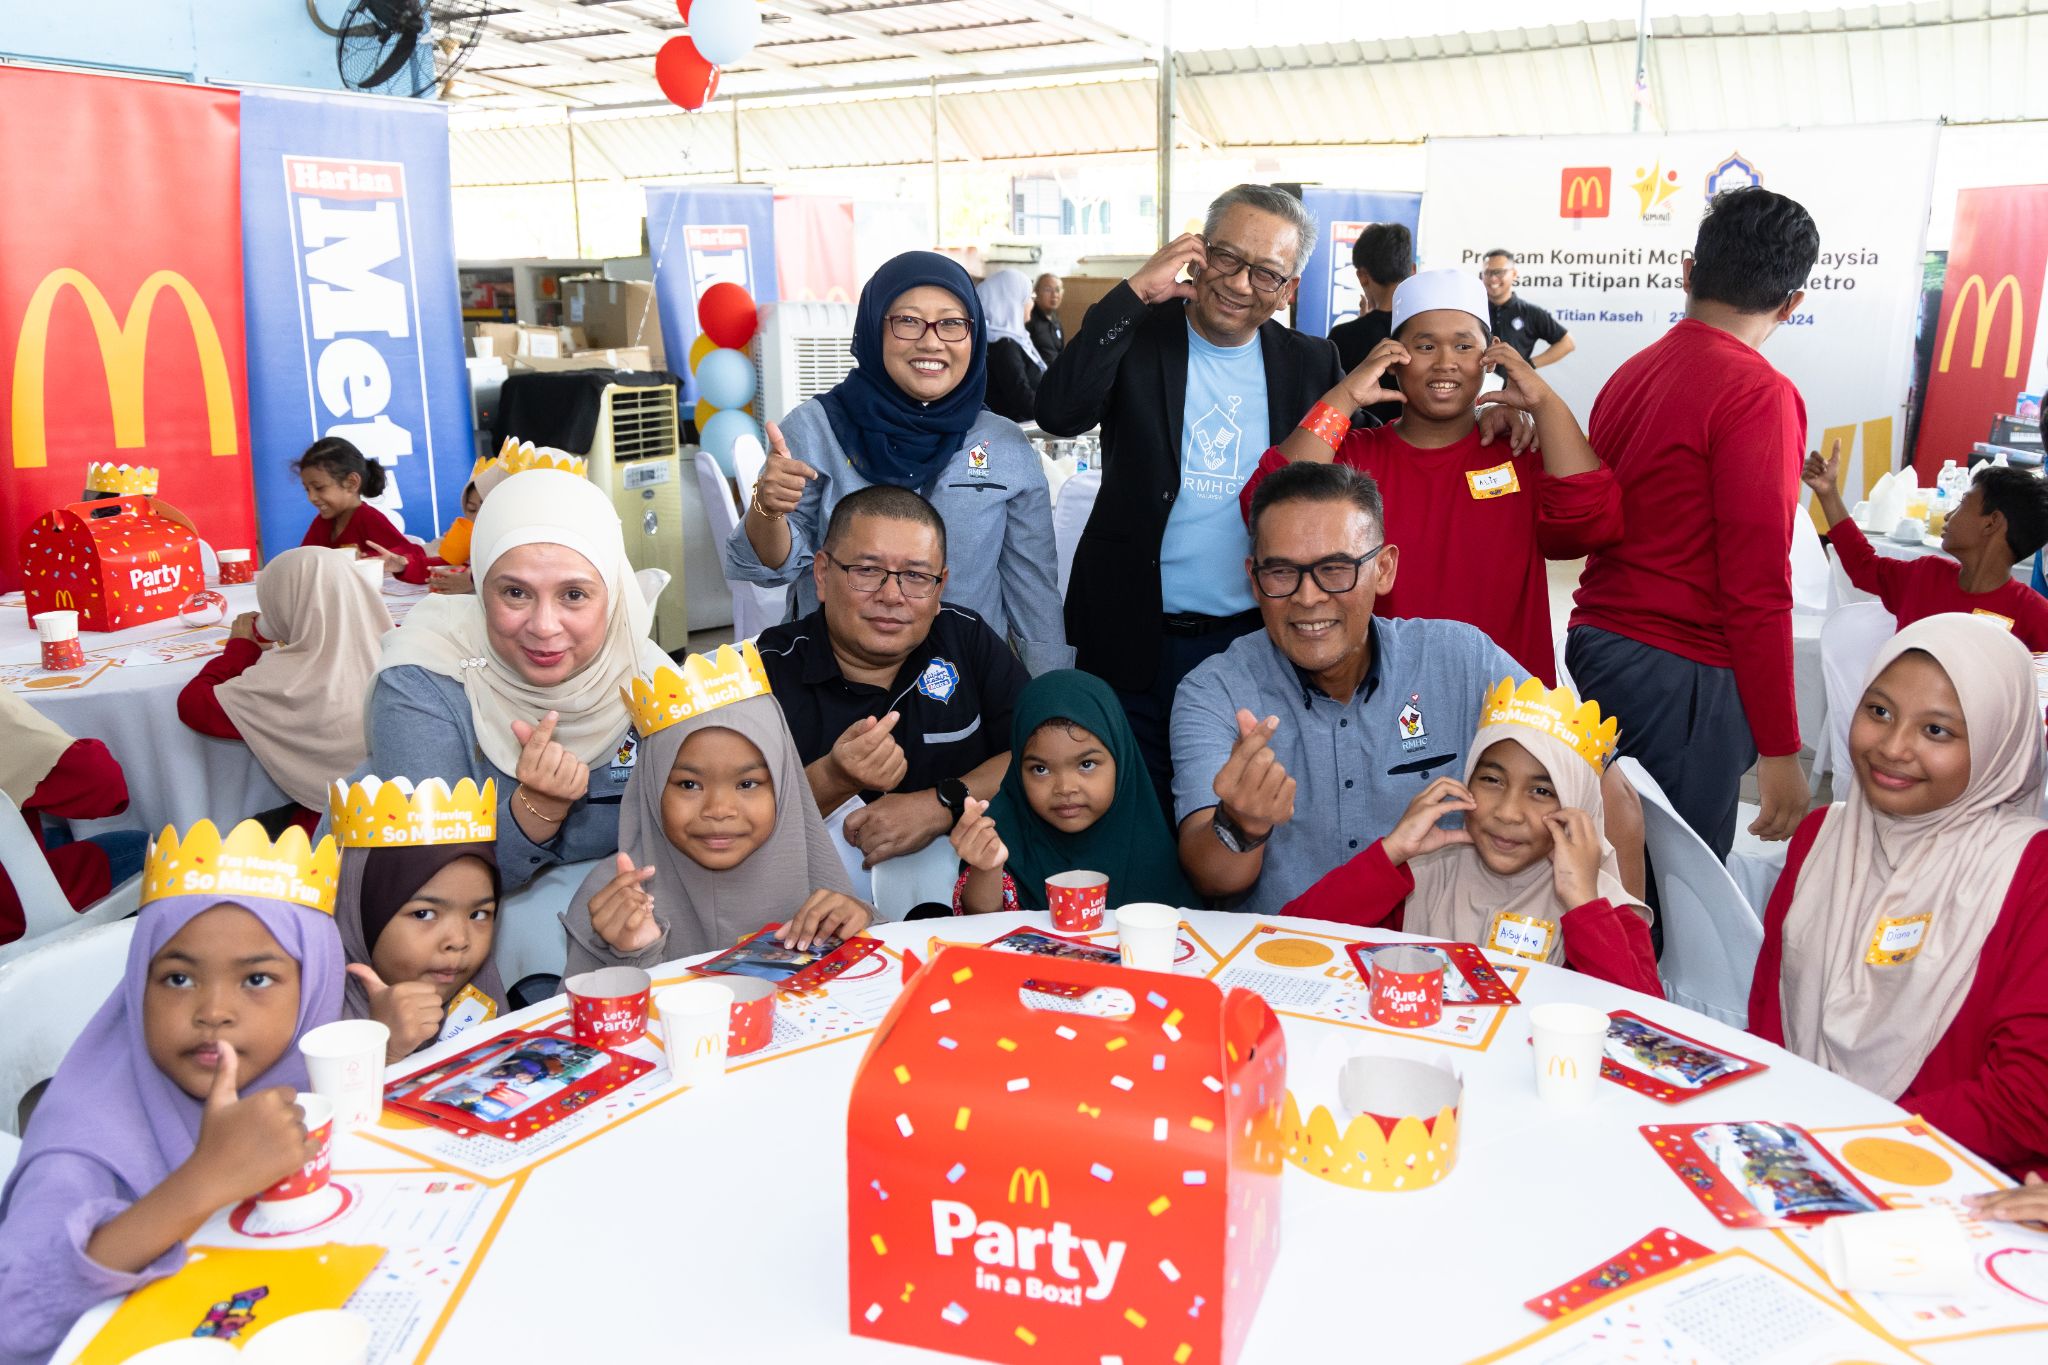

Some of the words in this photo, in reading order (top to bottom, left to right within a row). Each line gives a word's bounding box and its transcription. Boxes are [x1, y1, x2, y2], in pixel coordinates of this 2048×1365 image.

[293, 162, 394, 194] Harian
[1462, 249, 1544, 265] Pram
[1551, 248, 1642, 265] Komuniti
[1814, 247, 1879, 270] laysia
[1511, 274, 1563, 287] sama
[1569, 272, 1640, 292] Titipan
[1647, 274, 1683, 289] Kas
[1804, 274, 1856, 290] etro
[1556, 309, 1595, 322] Titian
[1600, 309, 1643, 323] Kaseh
[298, 197, 413, 535] Met
[967, 468, 990, 476] RMHC
[1183, 477, 1236, 495] RMHC
[129, 564, 181, 590] Party
[144, 588, 152, 597] in
[152, 588, 158, 596] a
[703, 671, 740, 688] Having
[668, 703, 692, 720] So
[1525, 700, 1562, 720] Having
[1490, 709, 1505, 722] So
[1506, 709, 1551, 731] Much
[1552, 720, 1580, 747] Fun
[1401, 737, 1428, 751] RMHC
[609, 768, 633, 780] RMH
[430, 809, 473, 823] Having
[382, 825, 408, 844] So
[410, 822, 466, 842] Much
[468, 821, 493, 840] Fun
[217, 853, 243, 868] I'm
[246, 856, 298, 878] Having
[183, 869, 215, 891] So
[217, 870, 287, 898] Much
[289, 878, 321, 905] Fun
[1381, 985, 1427, 1003] Party!
[602, 1009, 632, 1021] Let's
[1391, 1001, 1418, 1013] Let's
[592, 1014, 641, 1034] Party!
[931, 1198, 1127, 1301] Party
[975, 1265, 1001, 1292] in
[1004, 1276, 1021, 1296] a
[1025, 1275, 1082, 1307] Box!
